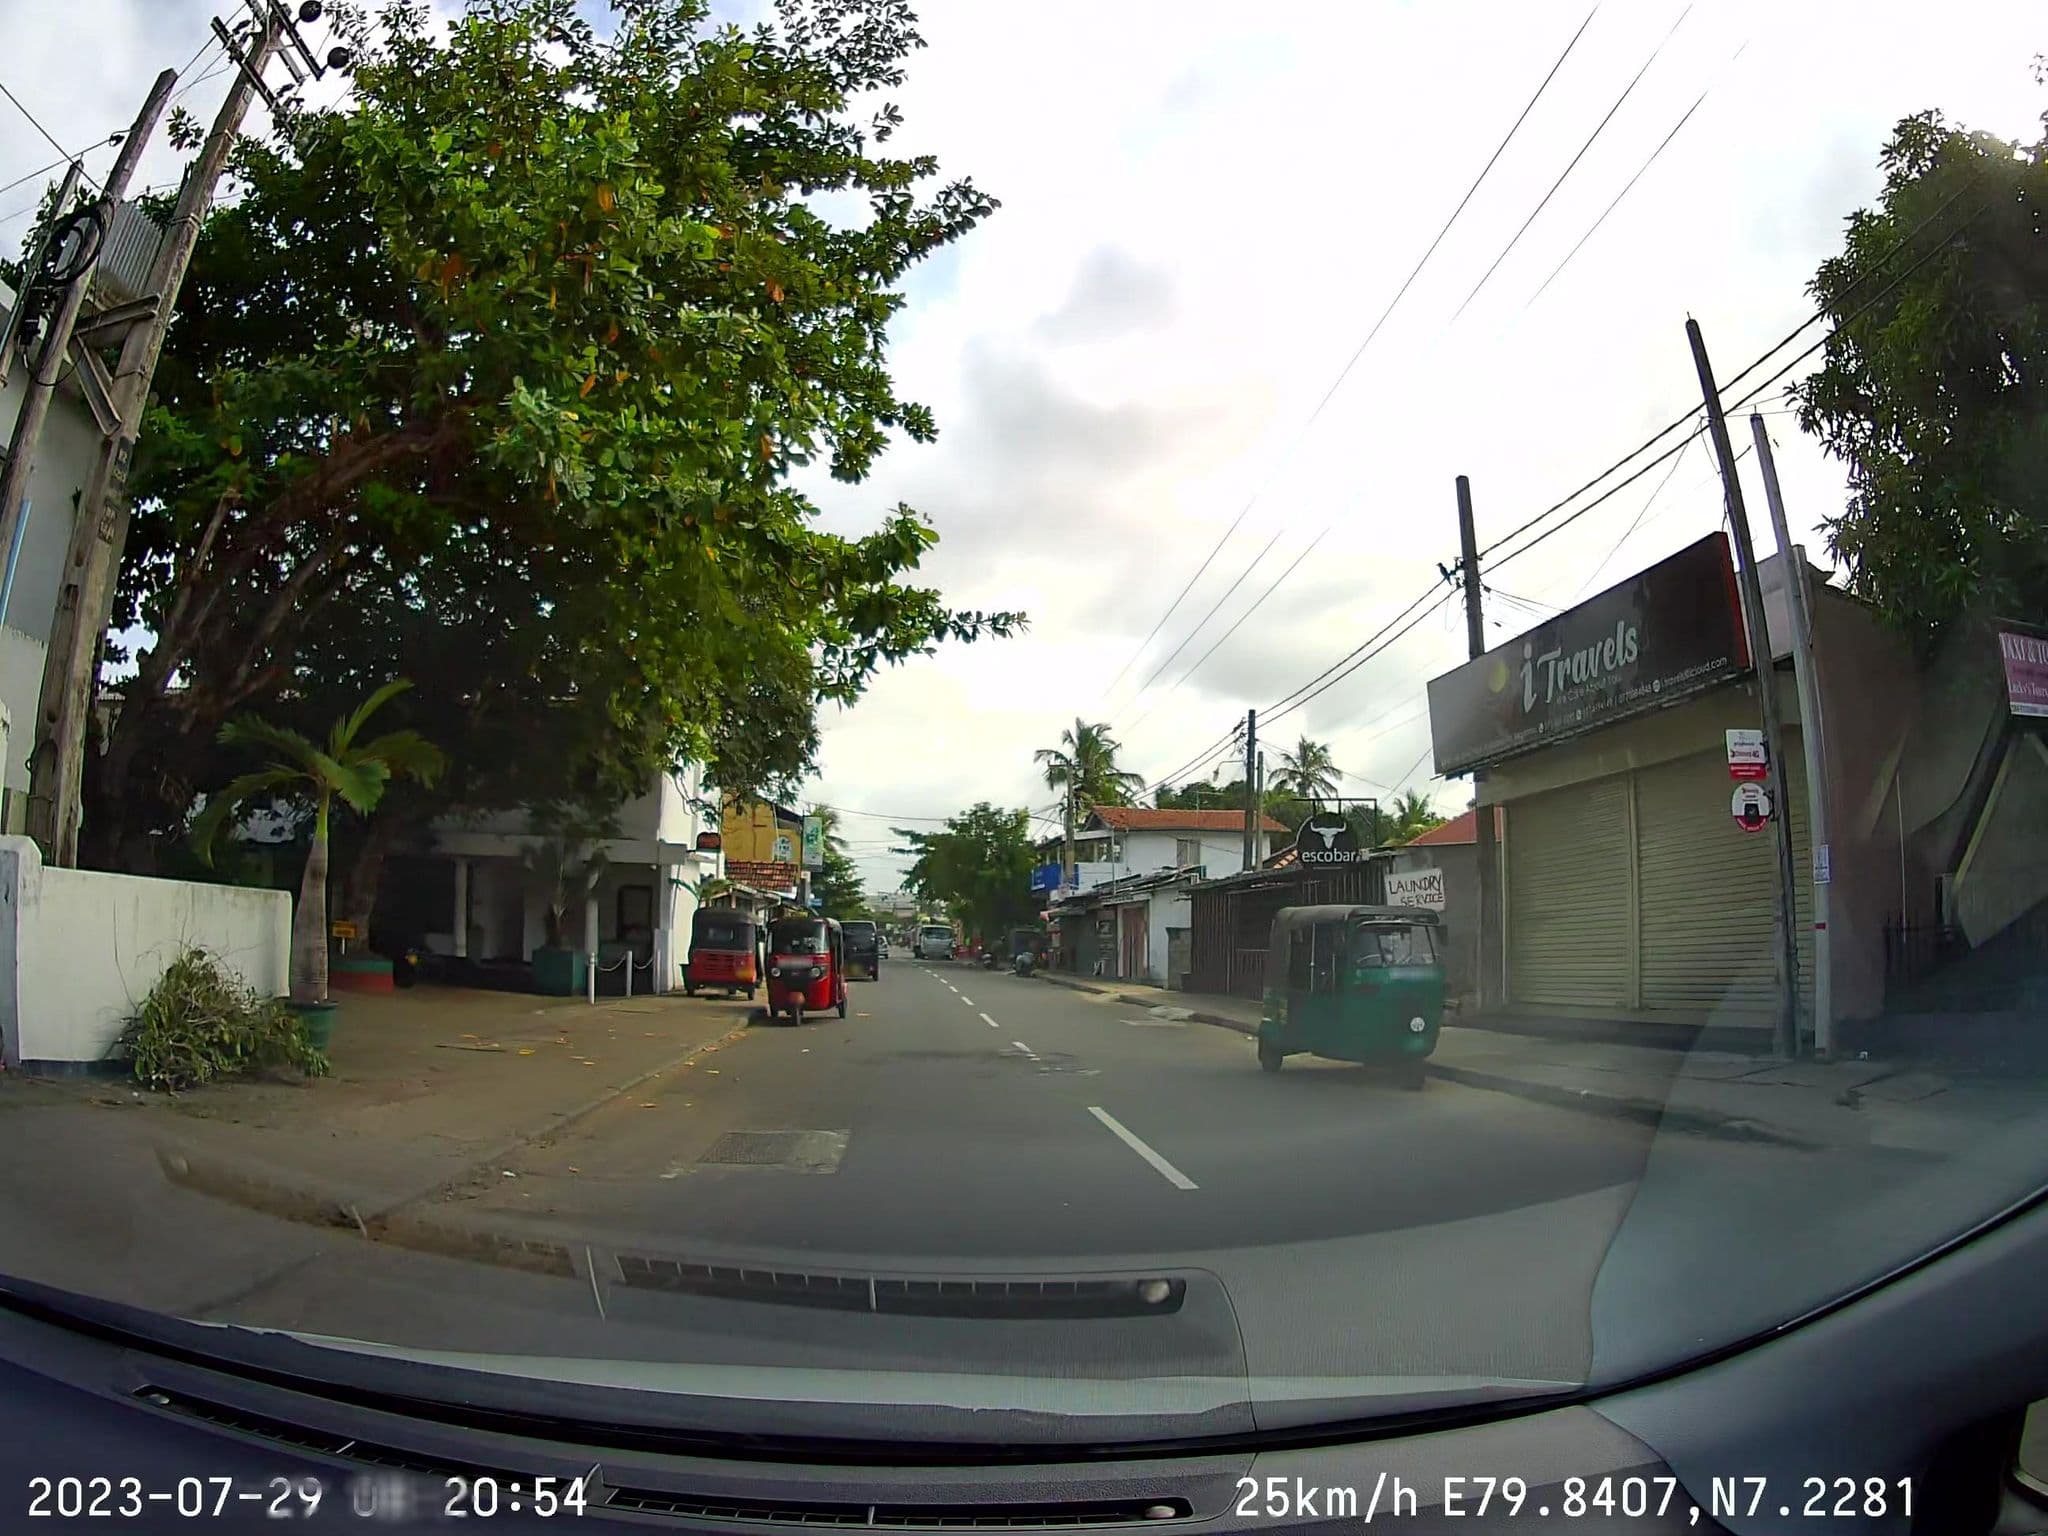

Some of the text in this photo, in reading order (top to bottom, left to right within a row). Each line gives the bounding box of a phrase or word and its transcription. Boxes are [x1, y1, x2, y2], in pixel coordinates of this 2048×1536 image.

[1520, 620, 1640, 713] i Travels
[1302, 848, 1357, 863] escobar
[1388, 874, 1442, 895] LAUNDRY
[1400, 892, 1444, 907] SERVICE
